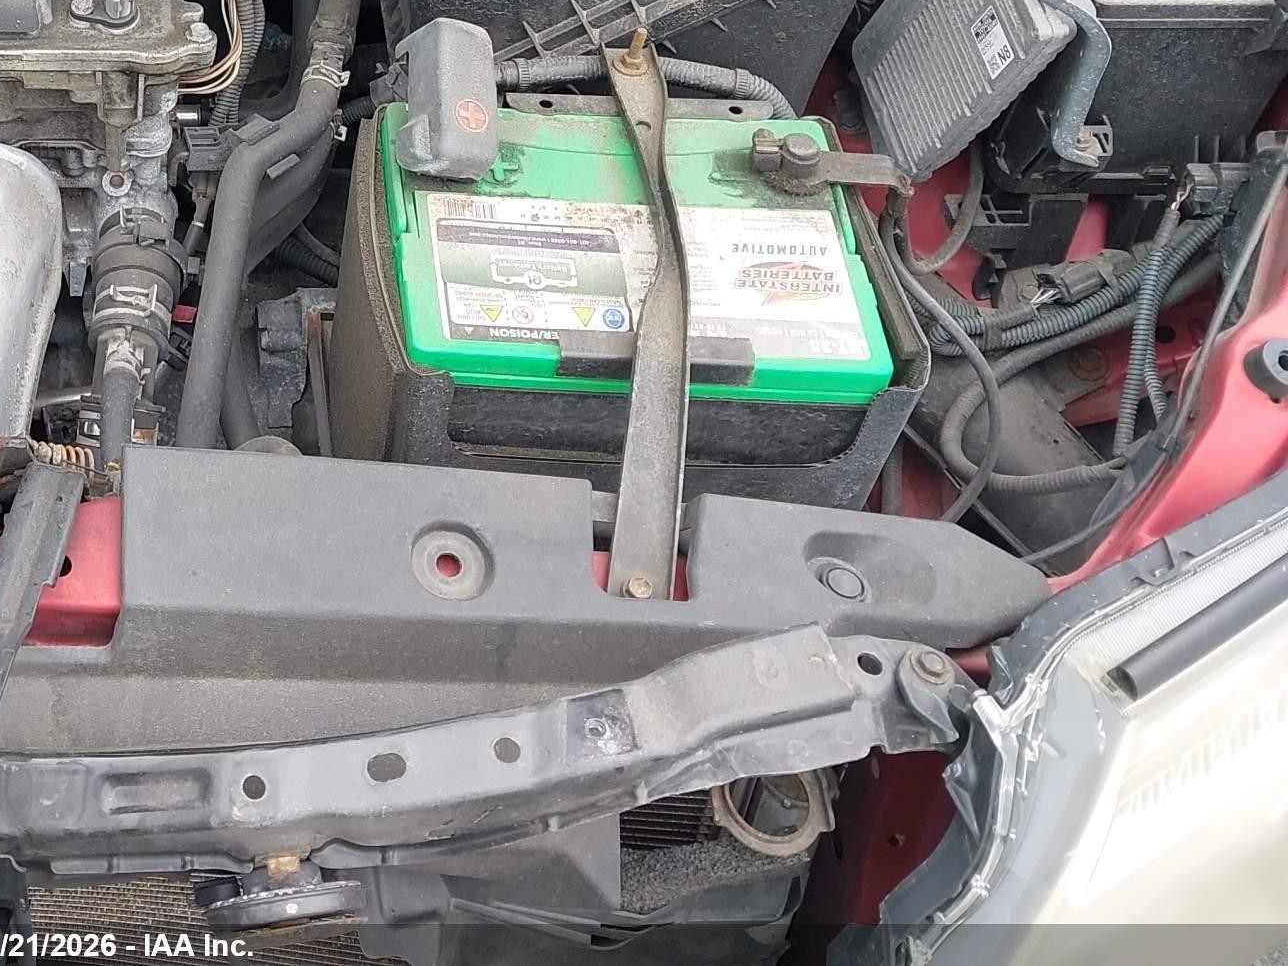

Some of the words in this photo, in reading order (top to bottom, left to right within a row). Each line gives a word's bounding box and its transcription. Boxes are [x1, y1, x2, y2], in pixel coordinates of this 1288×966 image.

[997, 44, 1011, 66] N8
[731, 244, 828, 257] AUTOMOTIVE
[741, 269, 835, 281] BATTERIES
[735, 278, 842, 293] INTERSTATE
[489, 326, 559, 341] ER/POISON
